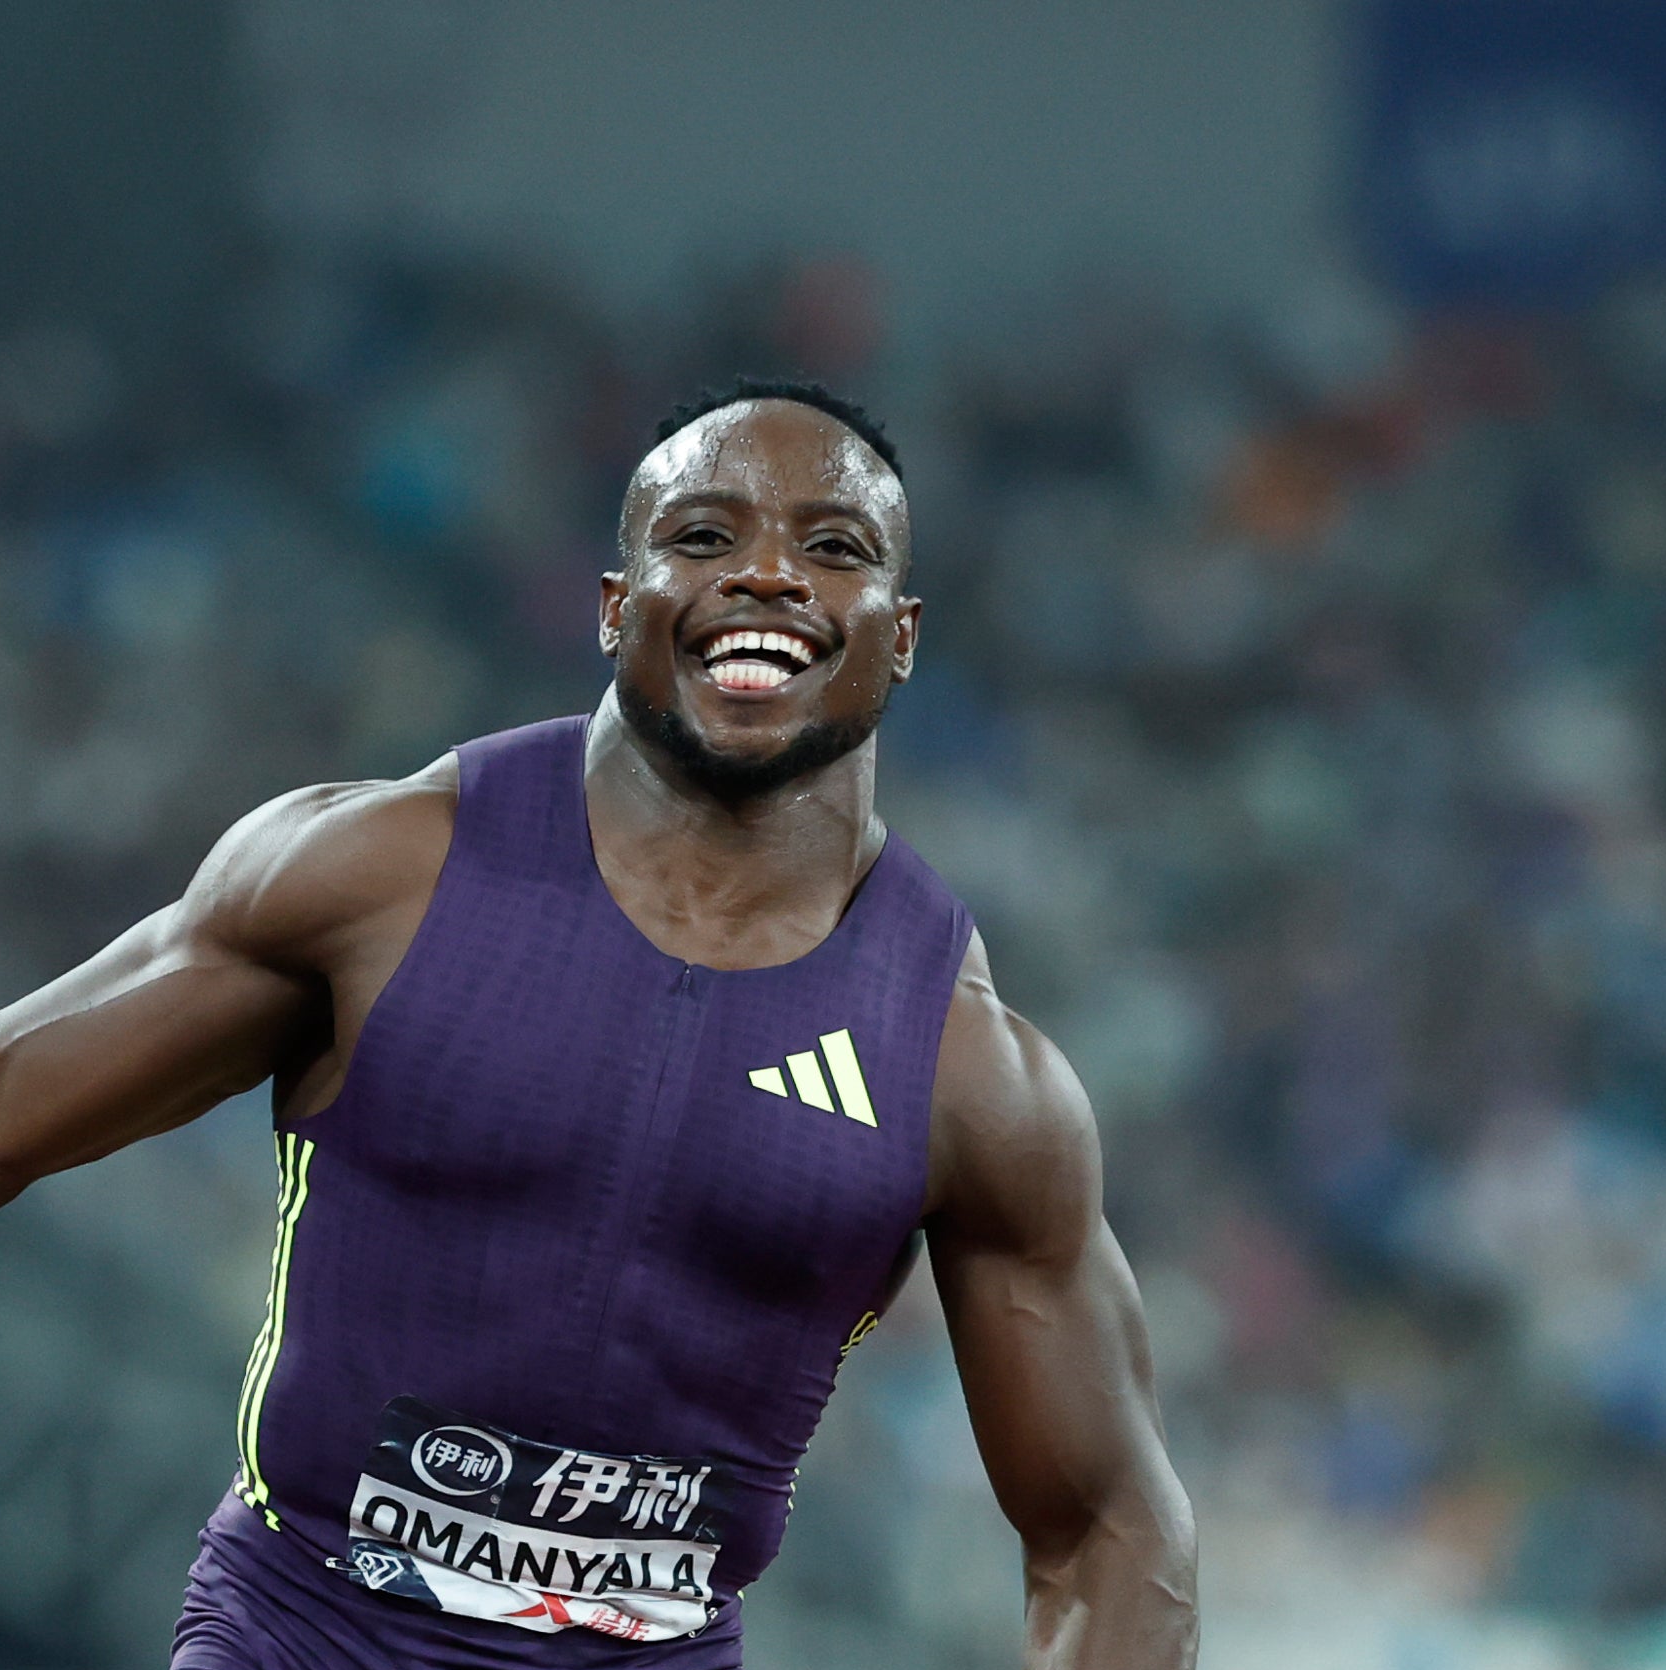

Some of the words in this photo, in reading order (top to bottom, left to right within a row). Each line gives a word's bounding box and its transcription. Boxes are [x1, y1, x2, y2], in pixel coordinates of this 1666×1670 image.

[424, 1437, 500, 1483] 伊利
[530, 1449, 713, 1533] 伊利
[360, 1494, 706, 1598] OMANYALA
